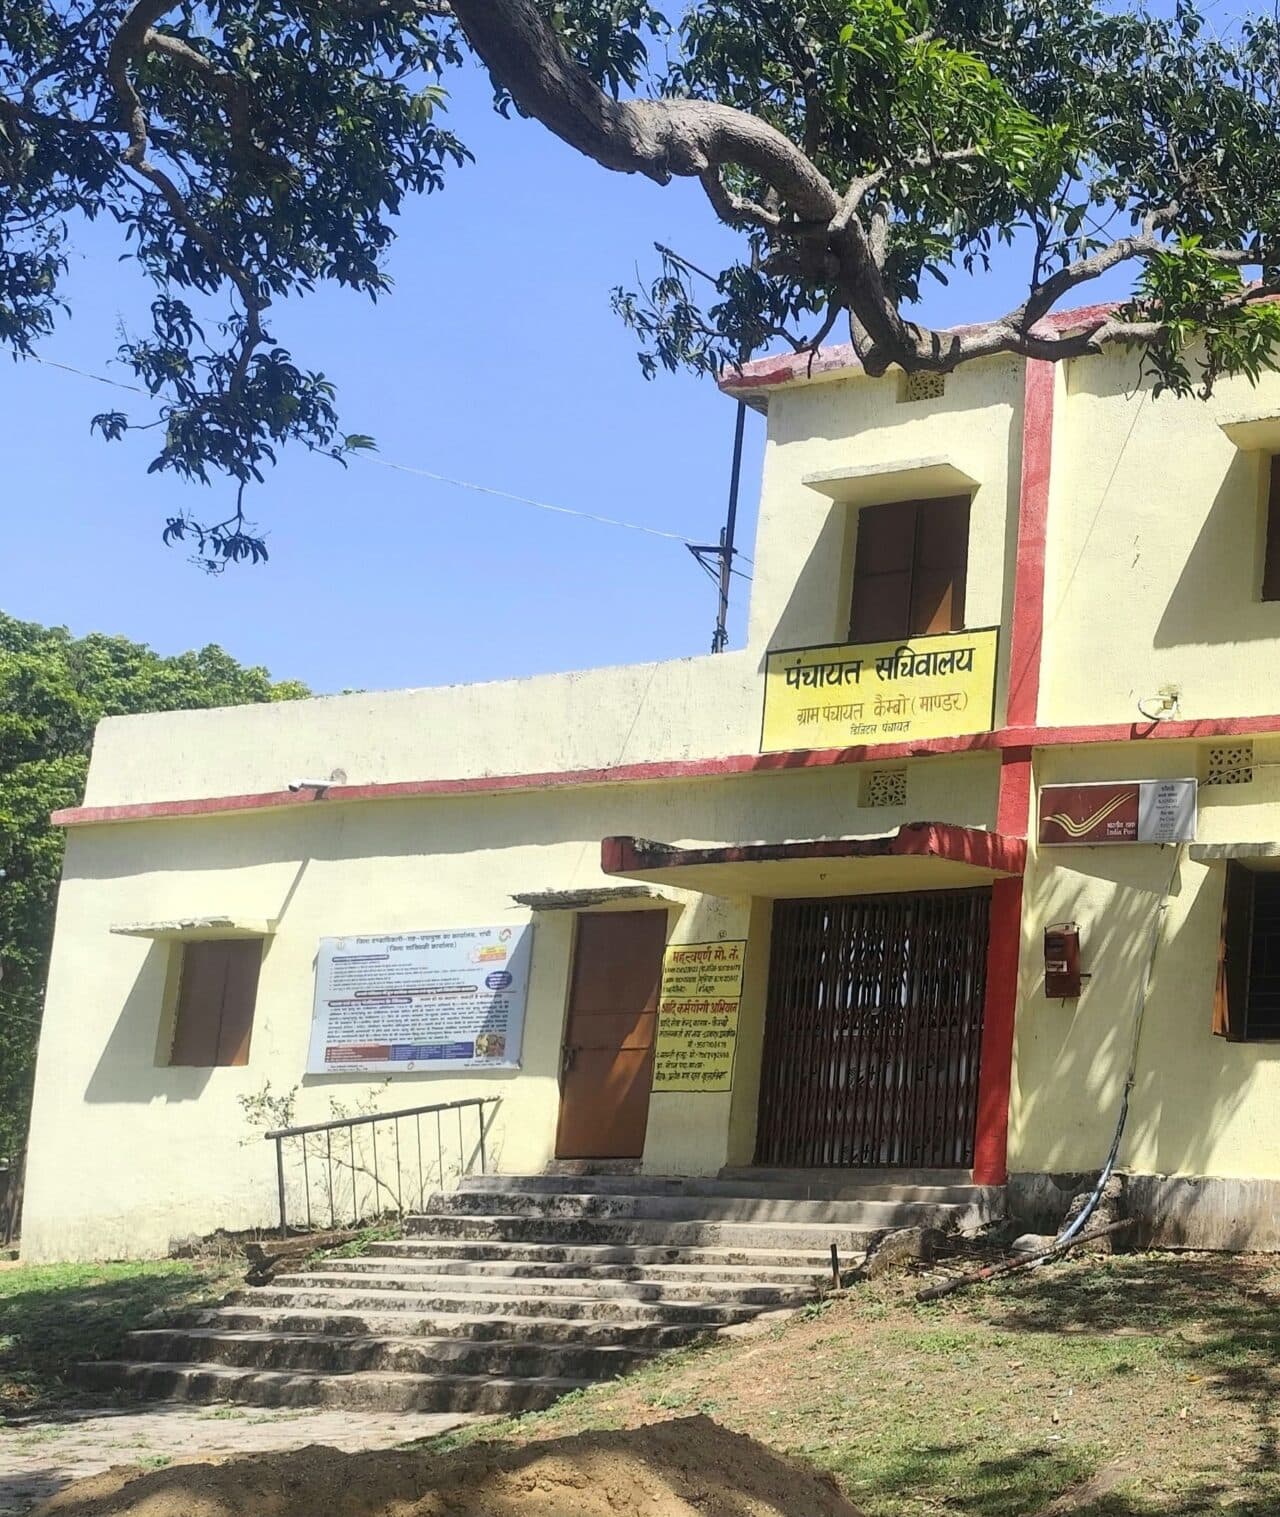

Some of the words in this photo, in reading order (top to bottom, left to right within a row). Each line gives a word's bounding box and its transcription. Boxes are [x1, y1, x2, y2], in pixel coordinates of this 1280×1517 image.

[784, 658, 864, 690] पंचायत
[875, 645, 976, 681] सचिवालय
[797, 707, 820, 725] ग्राम
[873, 692, 911, 717] कैम्बो
